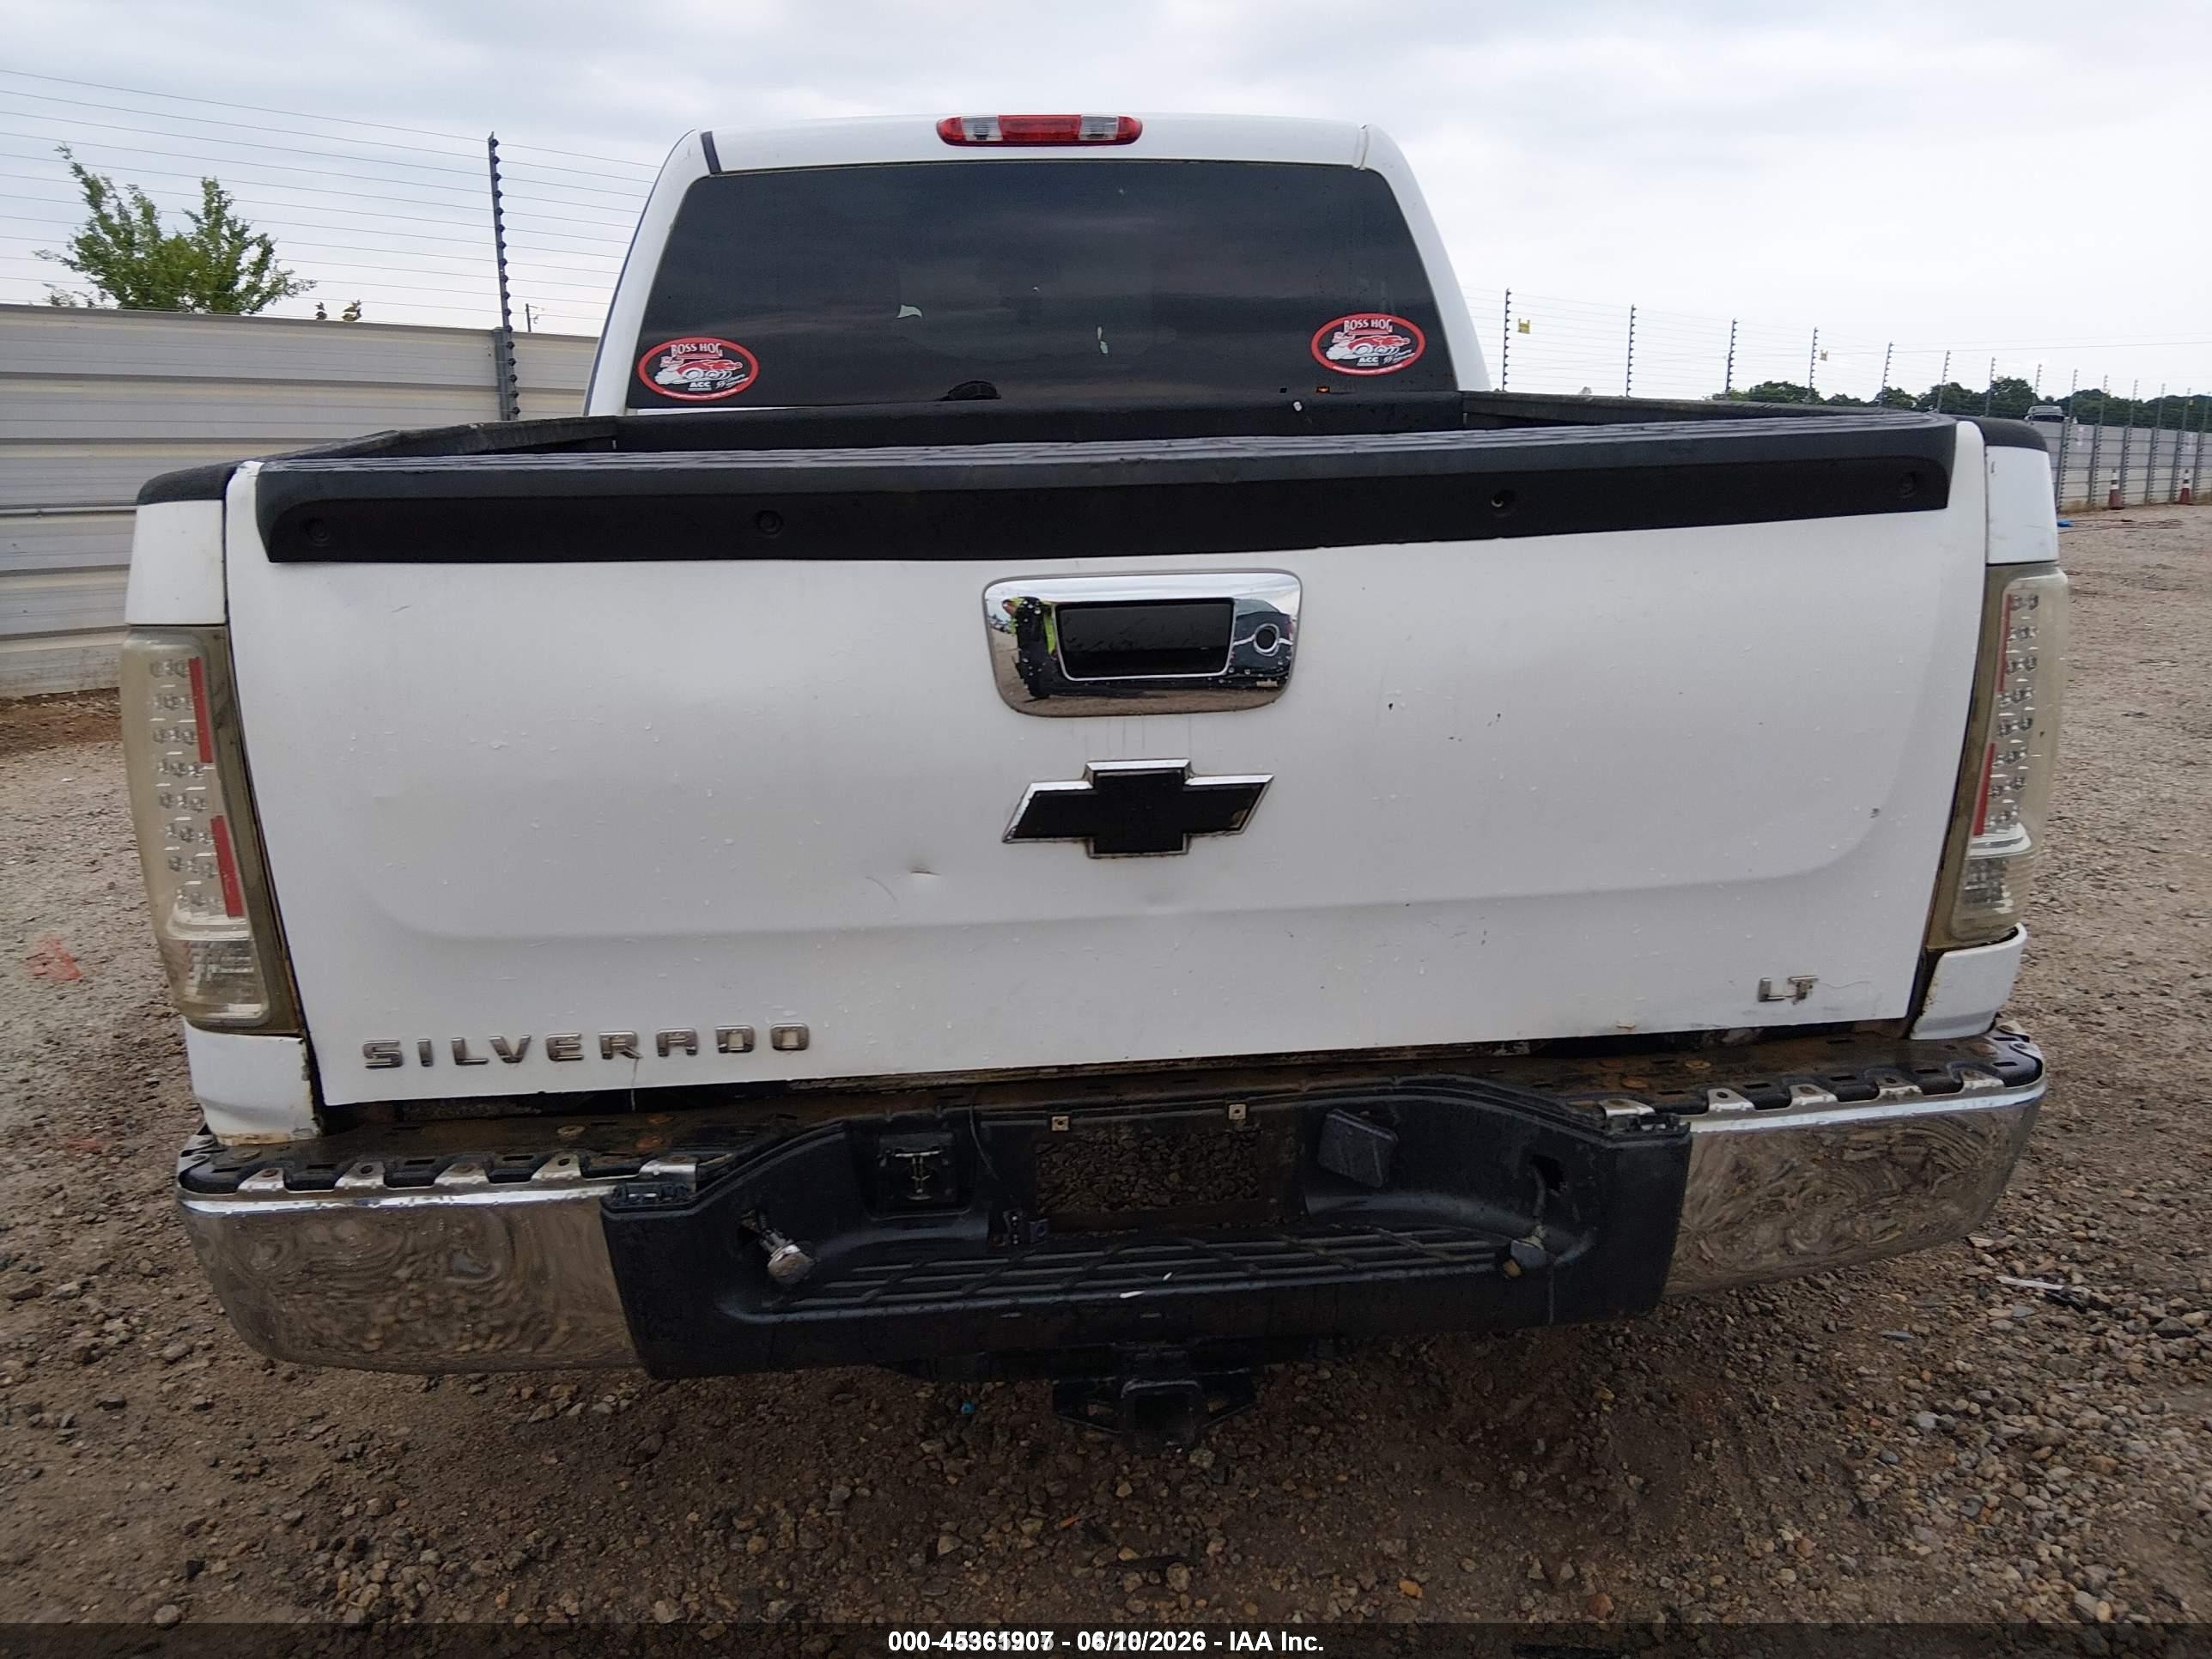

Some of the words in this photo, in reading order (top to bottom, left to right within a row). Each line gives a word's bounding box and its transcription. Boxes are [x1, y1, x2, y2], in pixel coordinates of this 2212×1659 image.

[1344, 319, 1369, 333] BOSS
[1370, 319, 1393, 333] HOG
[671, 343, 697, 357] BOSS
[700, 343, 723, 357] HOG
[1758, 975, 1819, 1005] LT
[362, 1022, 810, 1069] SILVERADO
